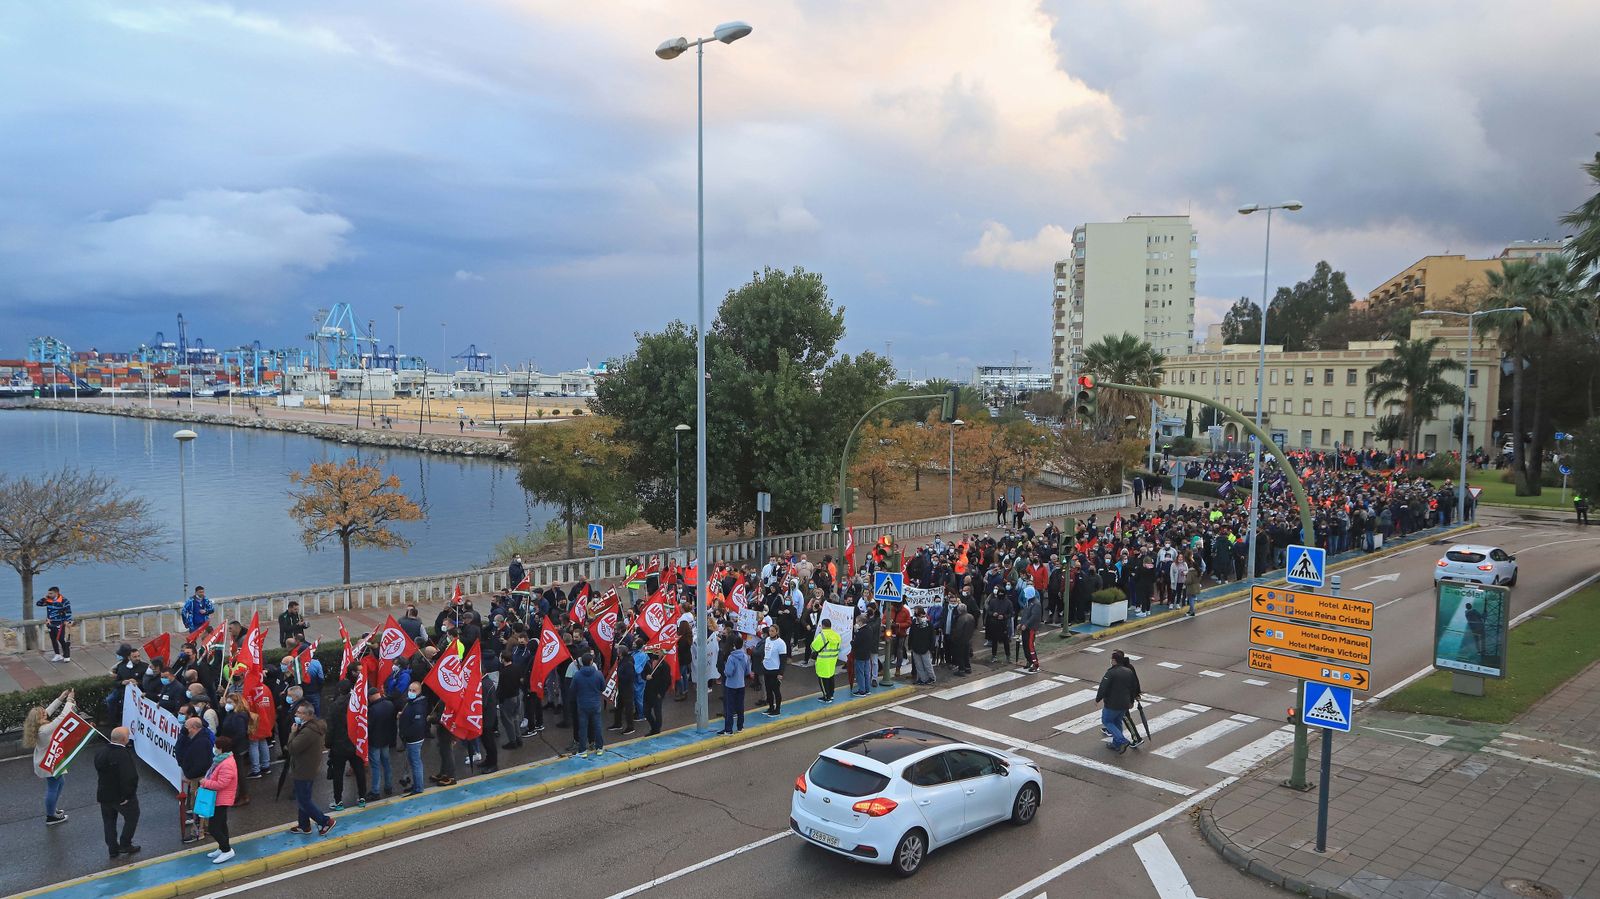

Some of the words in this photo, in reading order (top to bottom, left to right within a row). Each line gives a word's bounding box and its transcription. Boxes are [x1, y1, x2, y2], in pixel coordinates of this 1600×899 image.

[1319, 601, 1339, 609] Hotel
[1342, 604, 1371, 614] Al-Mar
[1295, 609, 1313, 617] Hotel
[1315, 611, 1336, 621] Reina
[1338, 615, 1370, 626] Cristina
[1301, 631, 1320, 639] Hotel
[1321, 634, 1337, 643] Don
[1339, 637, 1369, 648] Manuel
[1252, 652, 1272, 661] Hotel
[1288, 640, 1307, 649] Hotel
[1309, 643, 1335, 654] Marina
[1337, 649, 1368, 660] Victoria
[1251, 660, 1272, 669] Aura
[159, 714, 169, 734] EN
[146, 727, 154, 741] SU
